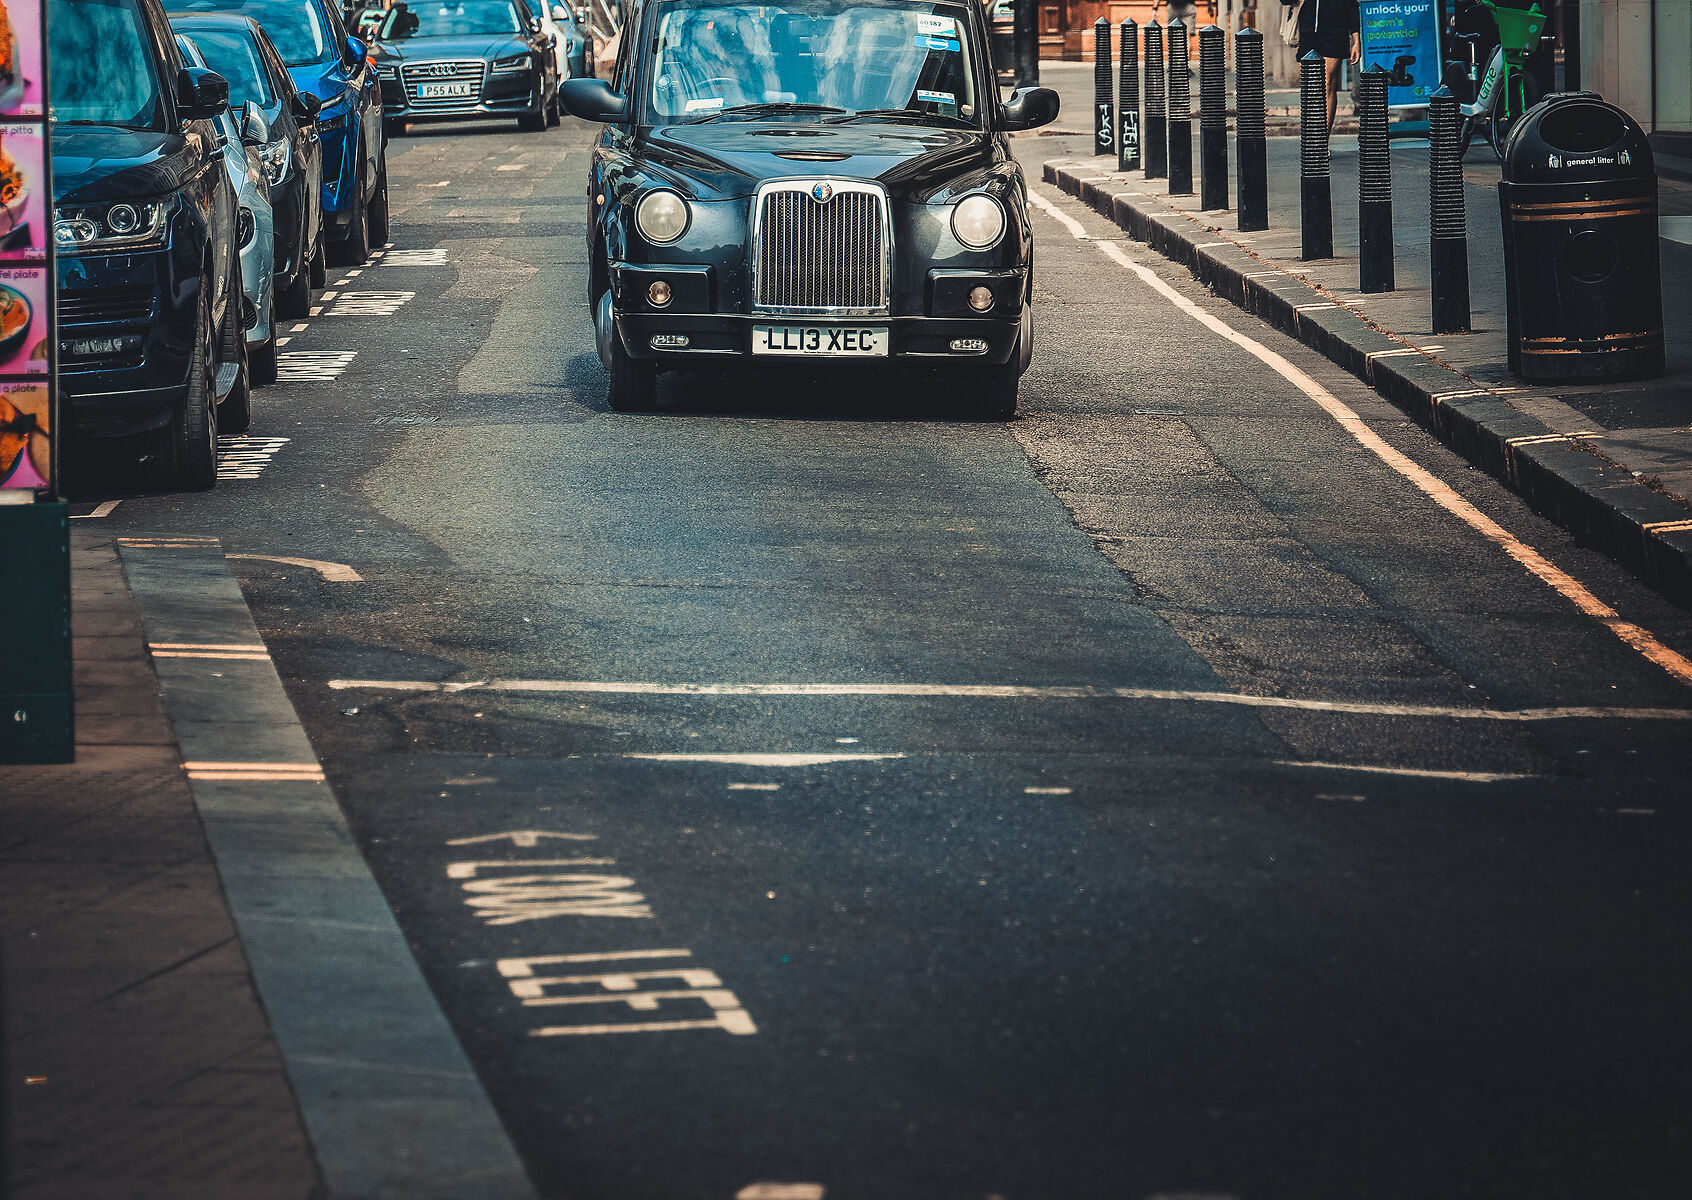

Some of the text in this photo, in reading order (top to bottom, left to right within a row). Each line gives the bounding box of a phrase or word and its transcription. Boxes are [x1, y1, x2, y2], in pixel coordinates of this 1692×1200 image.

[1365, 4, 1430, 16] unlock your
[1367, 17, 1404, 28] team's
[1367, 27, 1418, 42] potential
[426, 85, 466, 96] P55 ALX
[1566, 156, 1614, 168] general litter
[14, 270, 39, 280] plate
[767, 328, 873, 351] LL13 XEC
[12, 384, 37, 394] plate
[446, 858, 654, 925] LOOK
[497, 949, 758, 1036] LEFT
